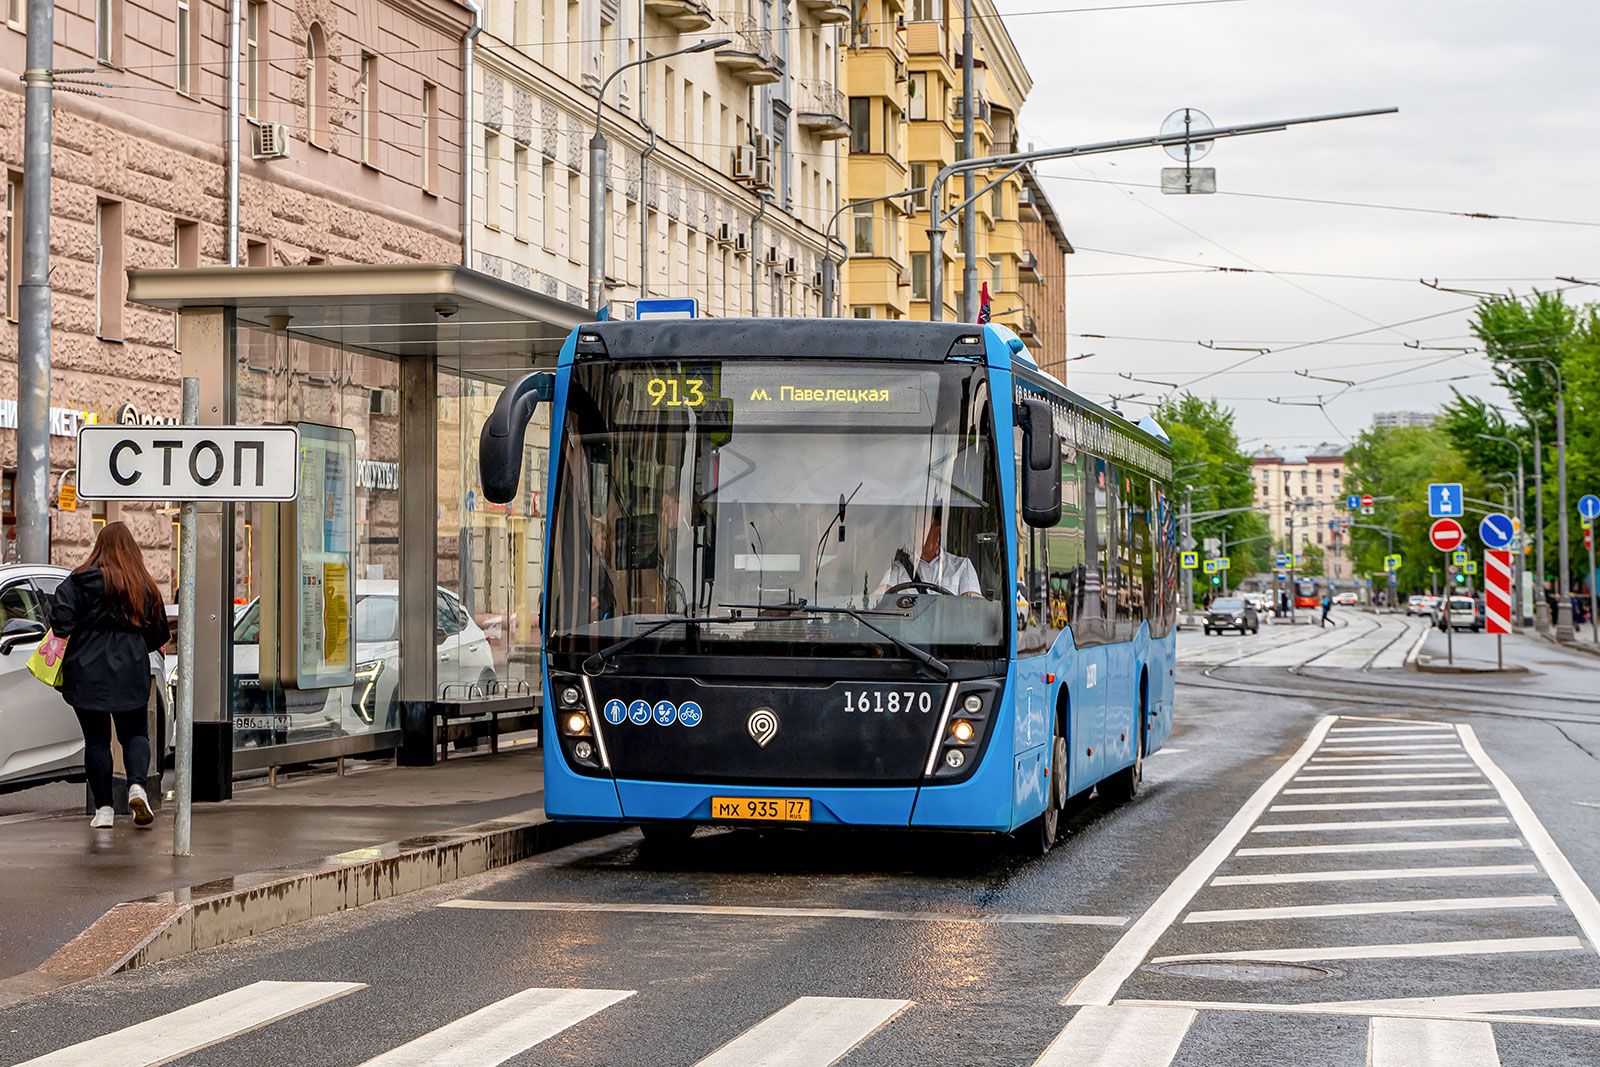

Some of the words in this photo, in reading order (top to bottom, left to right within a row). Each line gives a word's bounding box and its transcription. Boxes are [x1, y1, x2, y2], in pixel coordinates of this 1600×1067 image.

[647, 378, 705, 406] 913
[750, 388, 772, 401] м.
[780, 385, 889, 404] Павелецкая
[108, 439, 265, 487] СТОП
[844, 691, 932, 713] 161870
[747, 801, 778, 817] 935
[788, 801, 804, 814] 77
